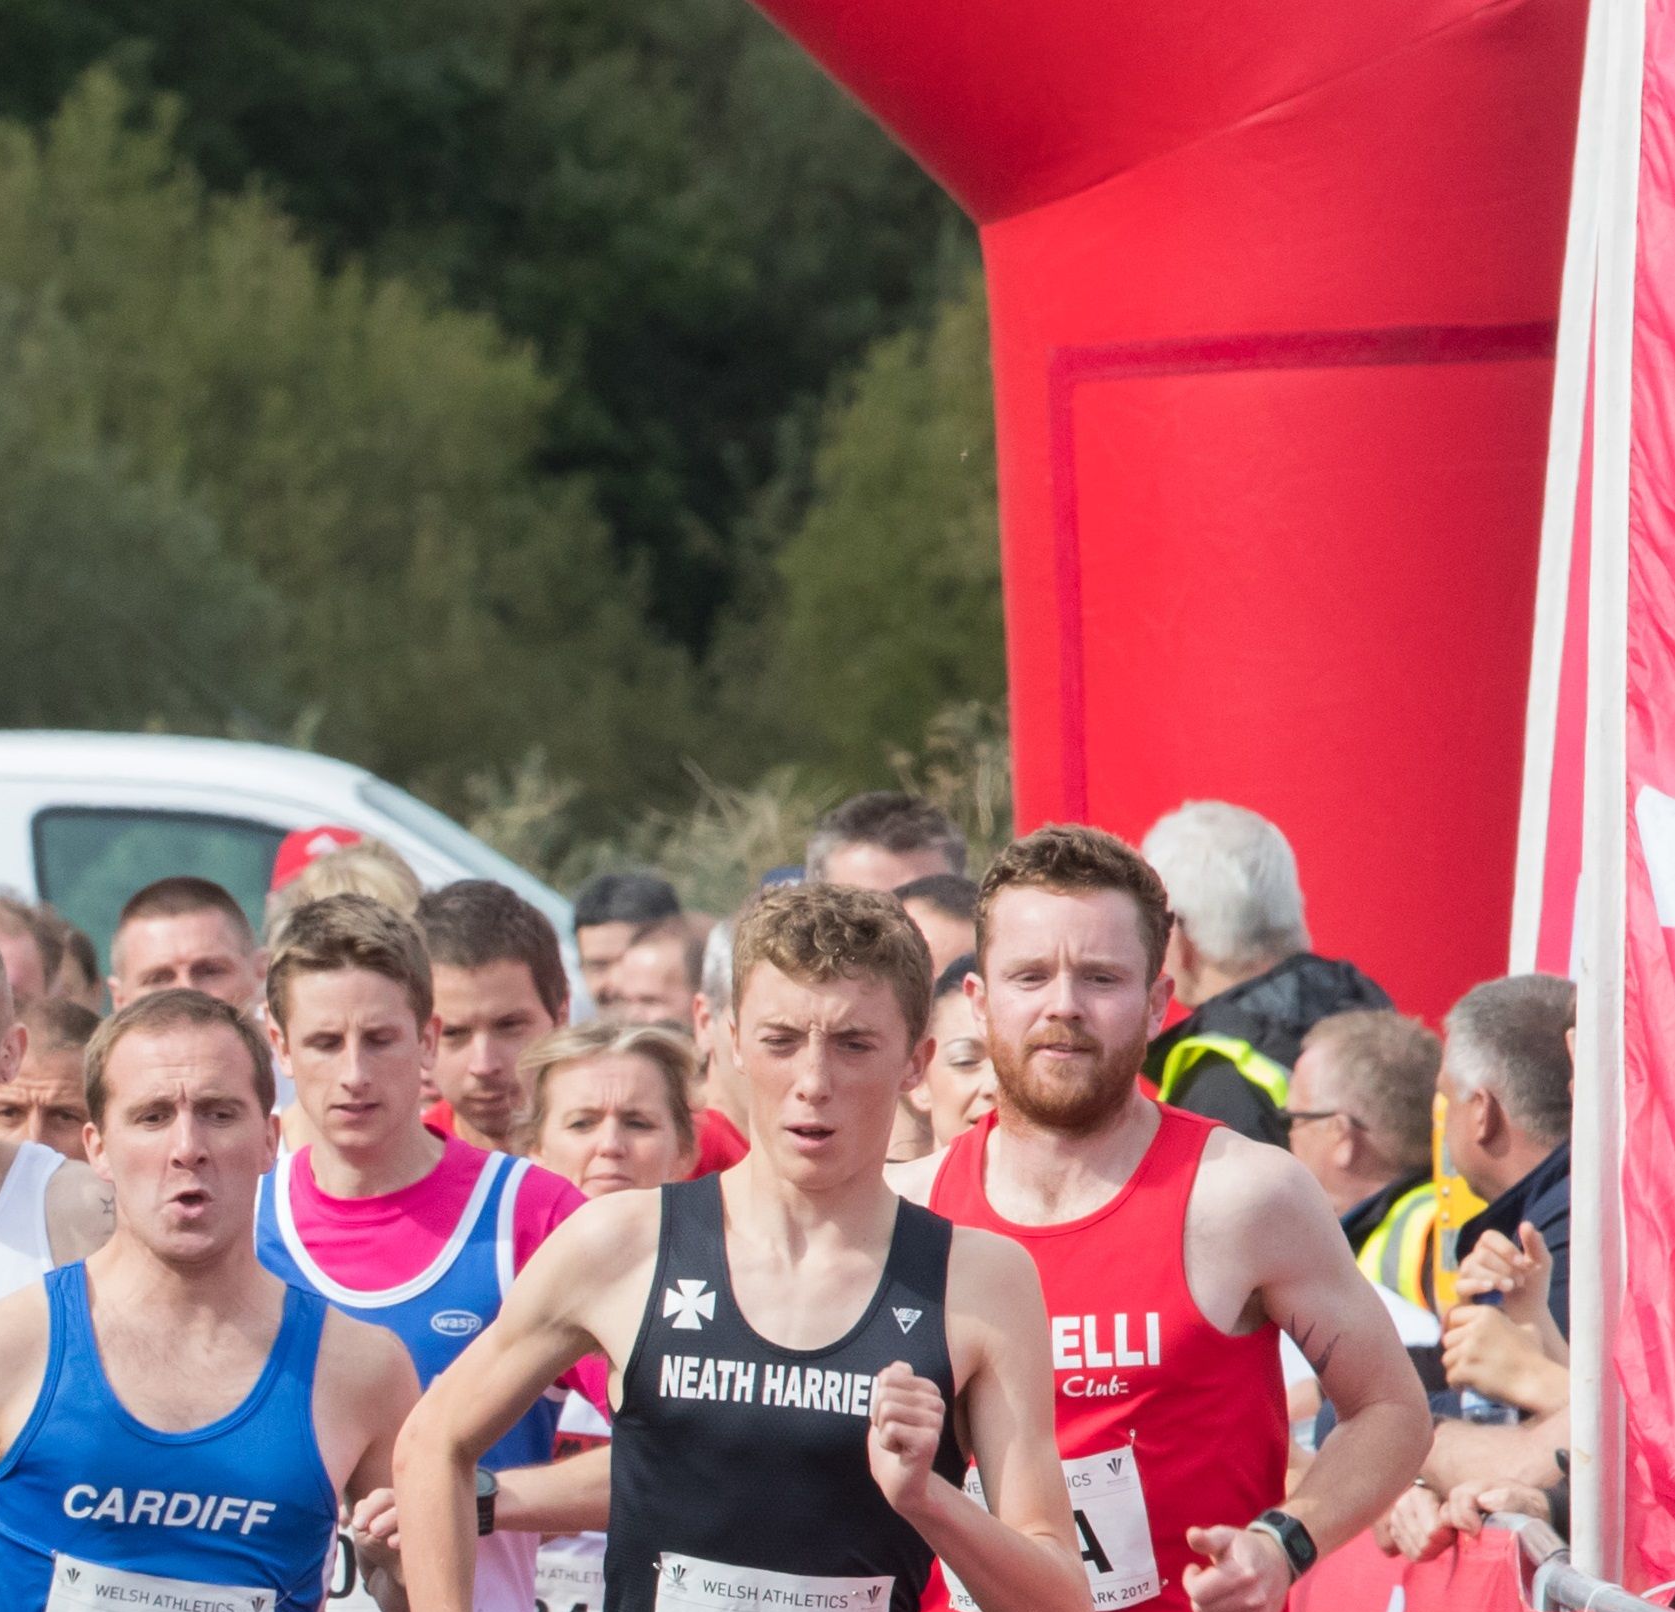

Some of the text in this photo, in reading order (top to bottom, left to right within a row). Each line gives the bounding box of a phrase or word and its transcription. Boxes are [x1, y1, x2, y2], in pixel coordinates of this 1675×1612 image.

[436, 1315, 479, 1333] wasp
[1051, 1312, 1160, 1370] ELLI
[660, 1354, 756, 1403] NEATH
[63, 1484, 276, 1535] CARDIFF
[95, 1583, 149, 1605] WELSH
[703, 1579, 848, 1609] WELSH ATHLETICS
